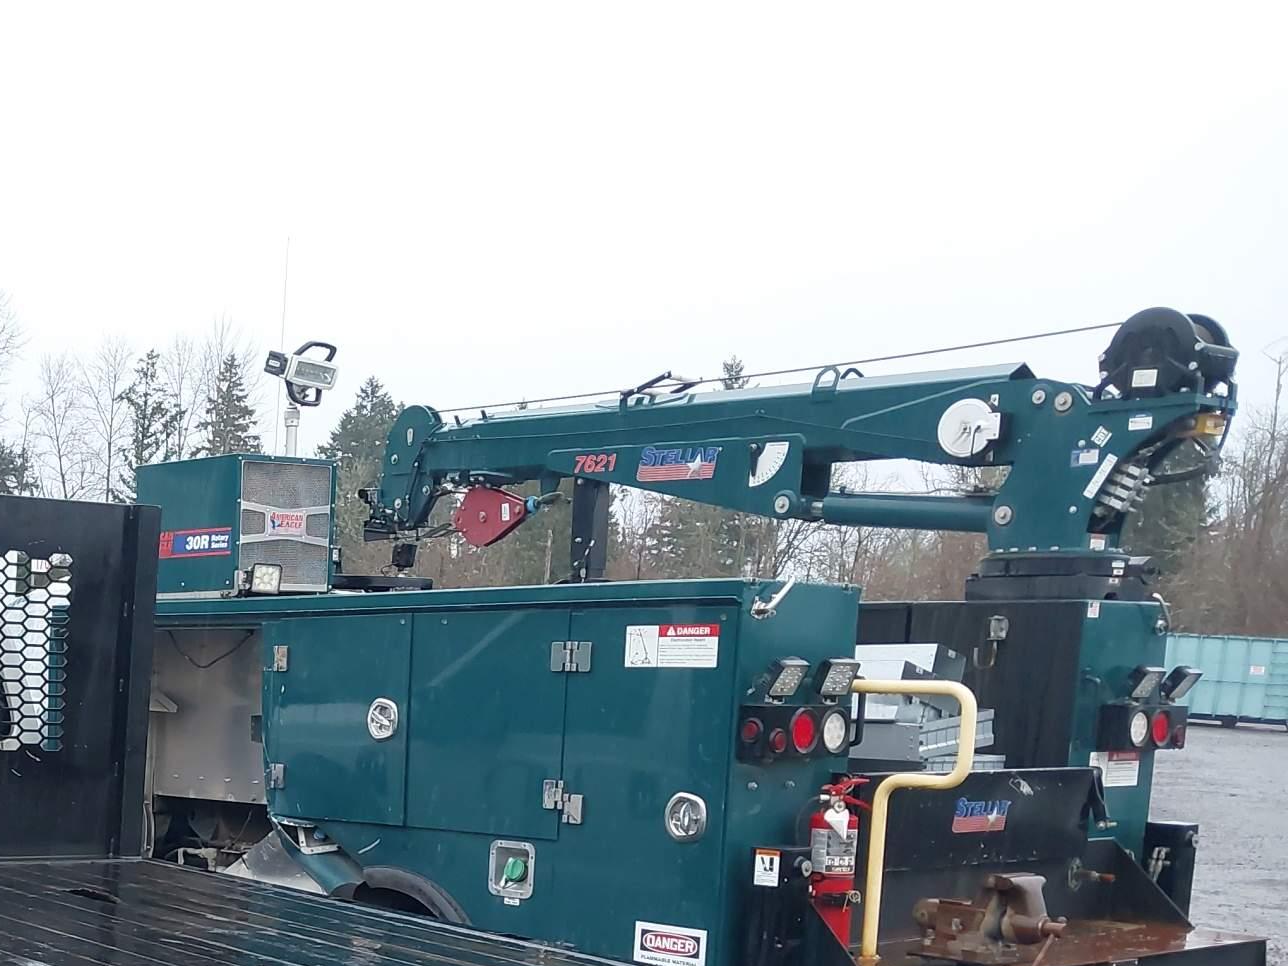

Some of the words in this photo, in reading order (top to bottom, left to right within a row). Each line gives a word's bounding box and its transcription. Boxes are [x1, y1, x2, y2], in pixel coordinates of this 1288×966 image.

[574, 453, 616, 473] 7621
[641, 446, 719, 466] STELLAR
[270, 512, 303, 521] AMERICAN
[280, 520, 303, 528] EAGLE
[185, 535, 209, 550] 30R
[676, 626, 711, 635] DANGER
[646, 934, 693, 952] DANGER
